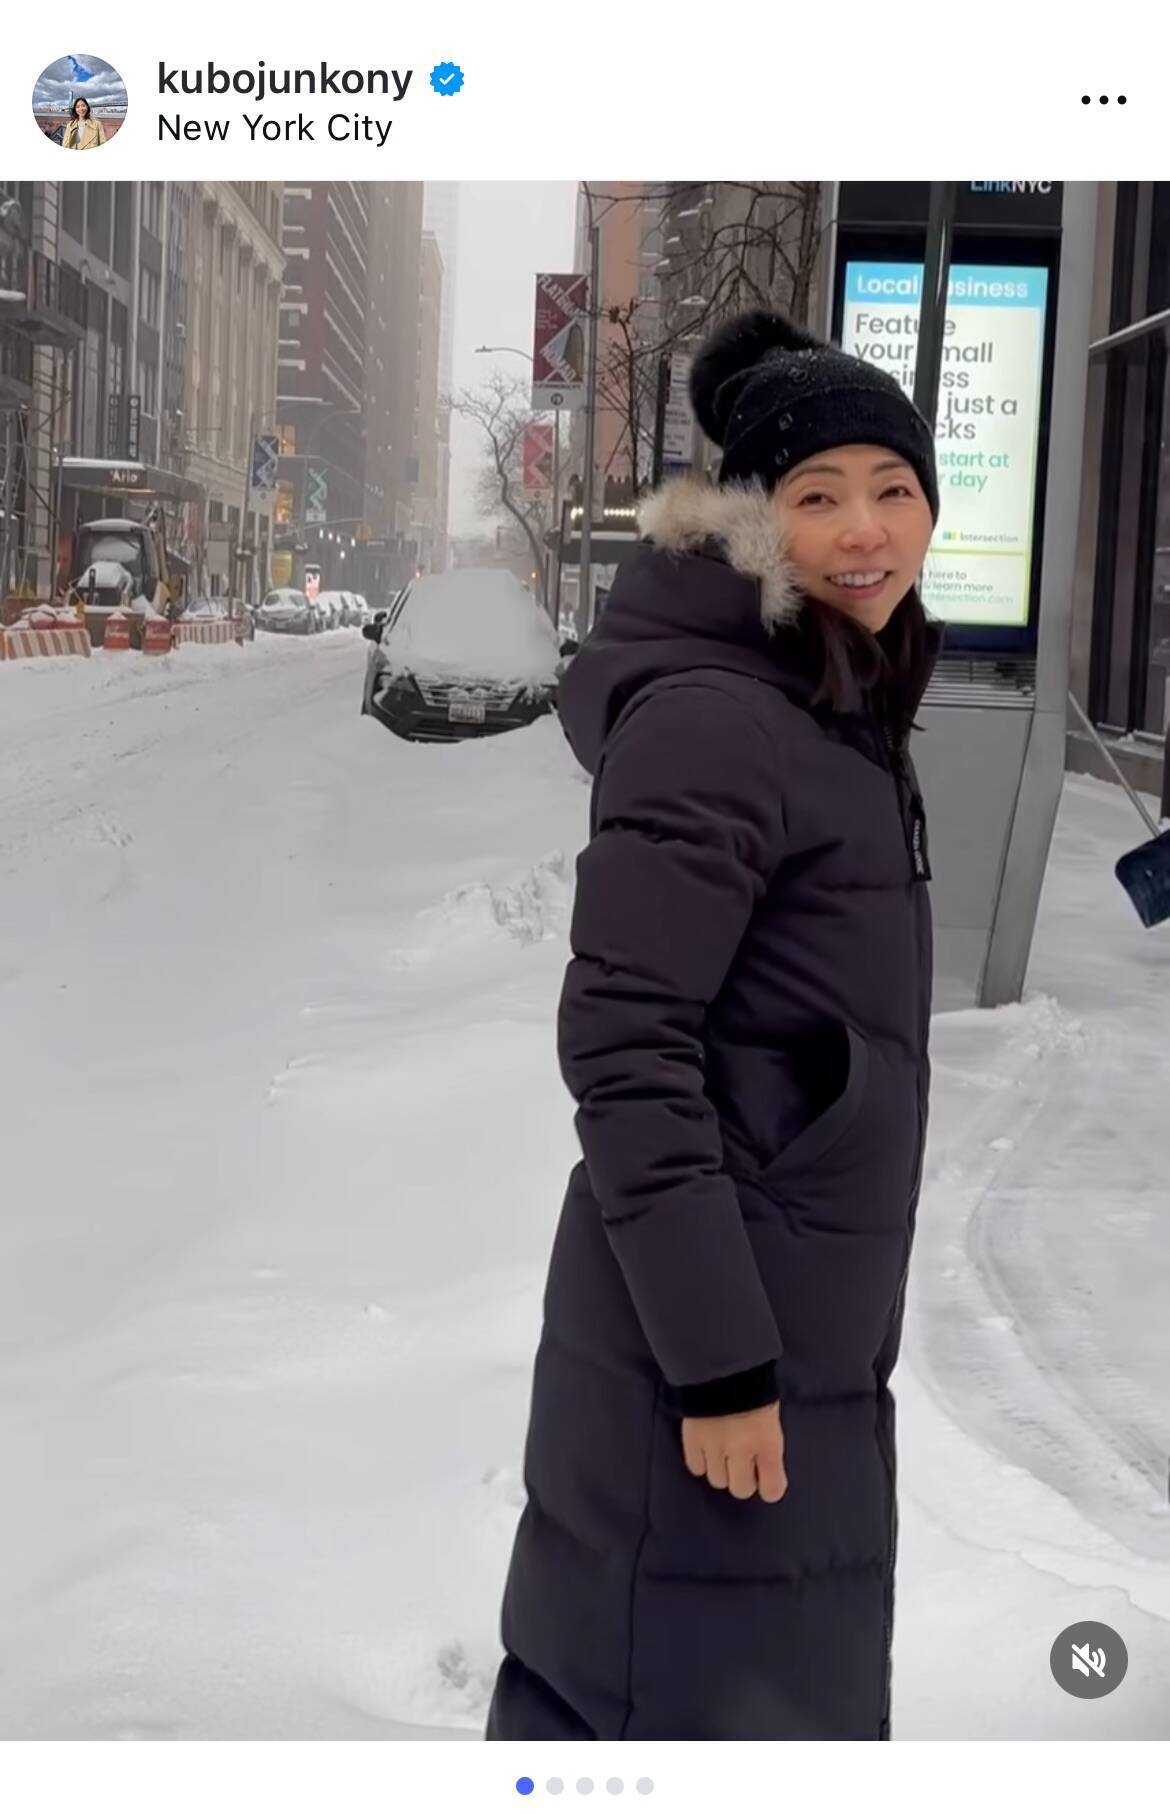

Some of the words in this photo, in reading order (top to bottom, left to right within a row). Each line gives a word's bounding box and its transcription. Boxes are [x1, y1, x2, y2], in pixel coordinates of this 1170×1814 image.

[970, 181, 1052, 193] LinkNYC
[857, 275, 918, 295] Local
[947, 276, 1028, 298] siness
[855, 313, 957, 336] Feate
[855, 343, 914, 361] your
[942, 342, 993, 363] mall
[945, 392, 995, 420] just
[1001, 400, 1018, 416] a
[939, 451, 985, 467] start
[988, 452, 1010, 468] at
[950, 471, 988, 493] day
[959, 530, 1019, 543] Intersection
[955, 571, 968, 580] to
[963, 584, 993, 592] more
